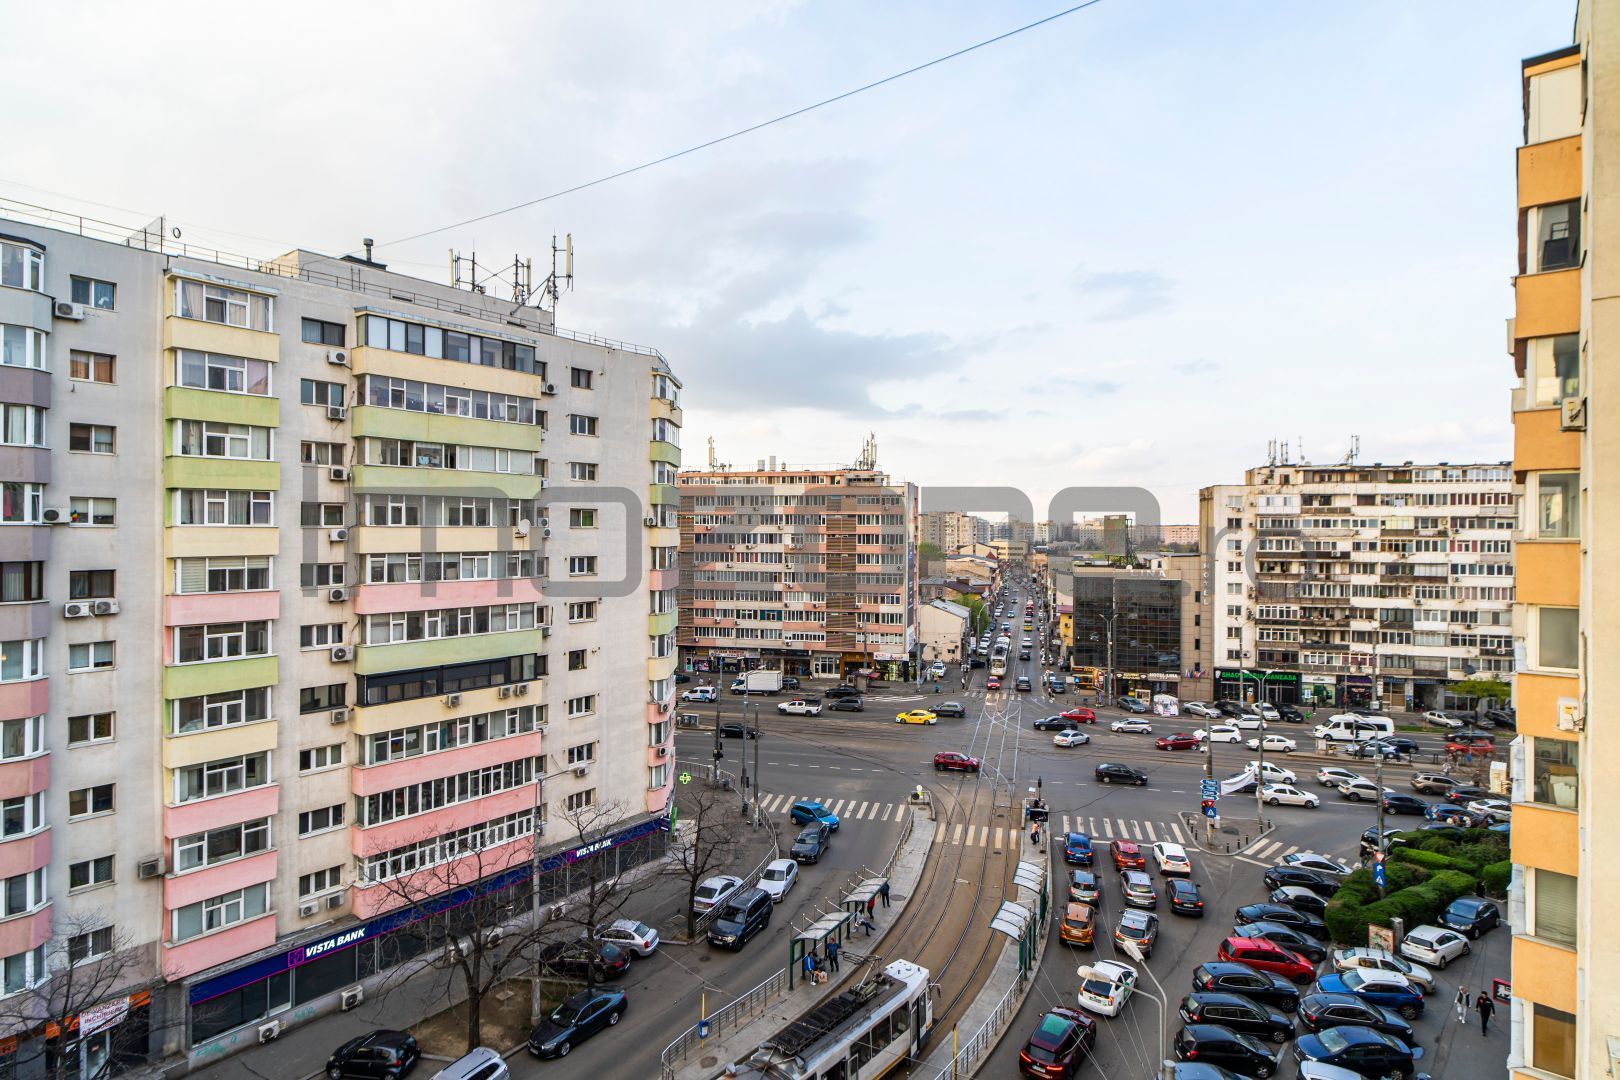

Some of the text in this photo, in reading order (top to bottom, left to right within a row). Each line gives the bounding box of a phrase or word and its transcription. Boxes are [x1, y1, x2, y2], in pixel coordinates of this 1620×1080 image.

[1131, 569, 1166, 577] LINA
[306, 927, 366, 957] VISTA BANK
